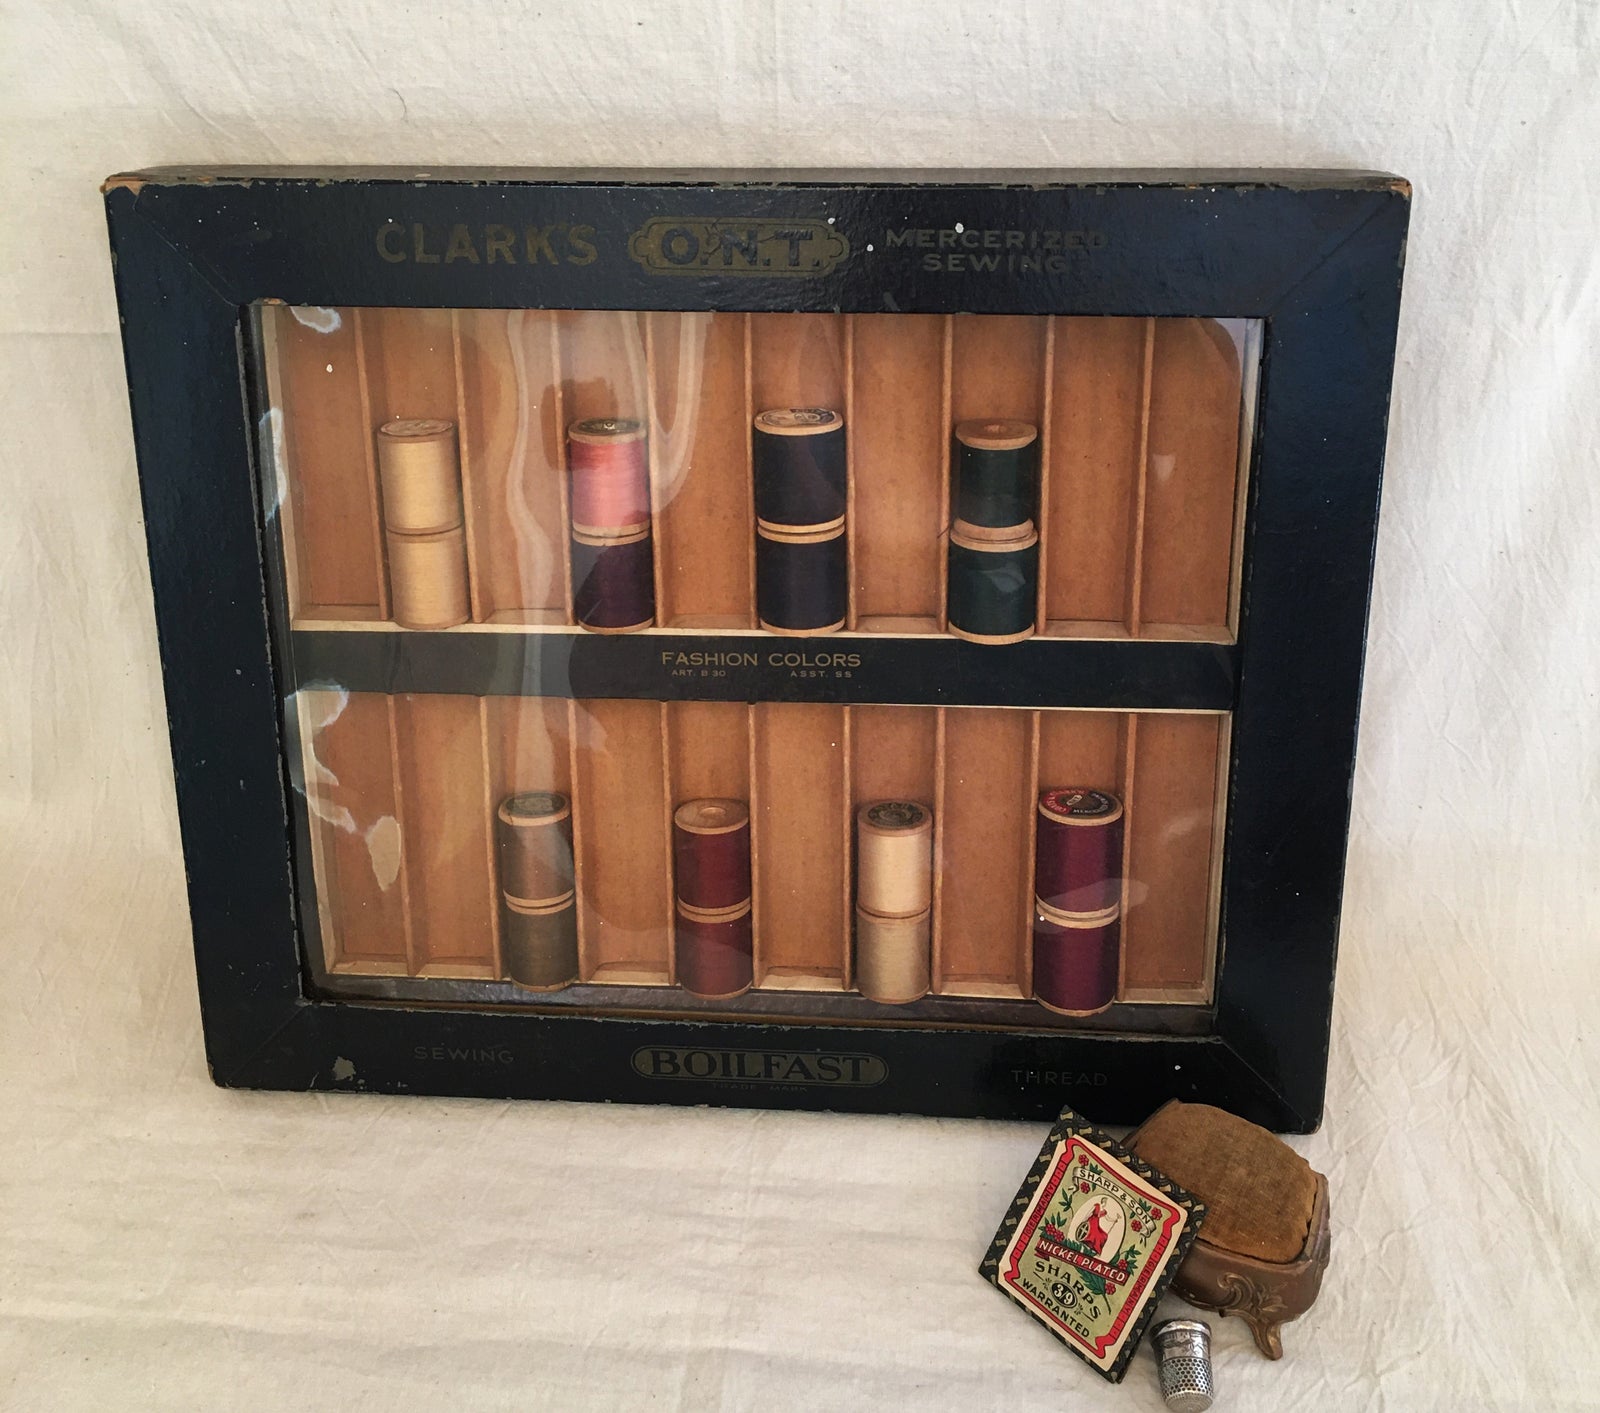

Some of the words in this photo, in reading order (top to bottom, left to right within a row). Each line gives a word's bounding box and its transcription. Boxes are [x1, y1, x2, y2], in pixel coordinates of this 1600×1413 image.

[885, 229, 1107, 248] MERCERIZED
[923, 253, 1067, 273] SEWING
[662, 652, 758, 666] FASHION
[768, 653, 861, 667] COLORS
[414, 1046, 514, 1064] SEWING
[651, 1051, 870, 1082] BOILFAST
[1011, 1070, 1108, 1086] THREAD
[1024, 1184, 1055, 1236] GERMANY
[1080, 1169, 1119, 1193] SHARP
[1120, 1192, 1127, 1202] &
[1129, 1200, 1151, 1225] SON
[1039, 1240, 1078, 1263] NICKEL
[1081, 1258, 1125, 1282] PLATED
[1034, 1260, 1101, 1319] SHARPS
[1053, 1284, 1074, 1304] 3/9
[1124, 1262, 1155, 1313] GERMANY
[1022, 1278, 1090, 1338] WARRANTED
